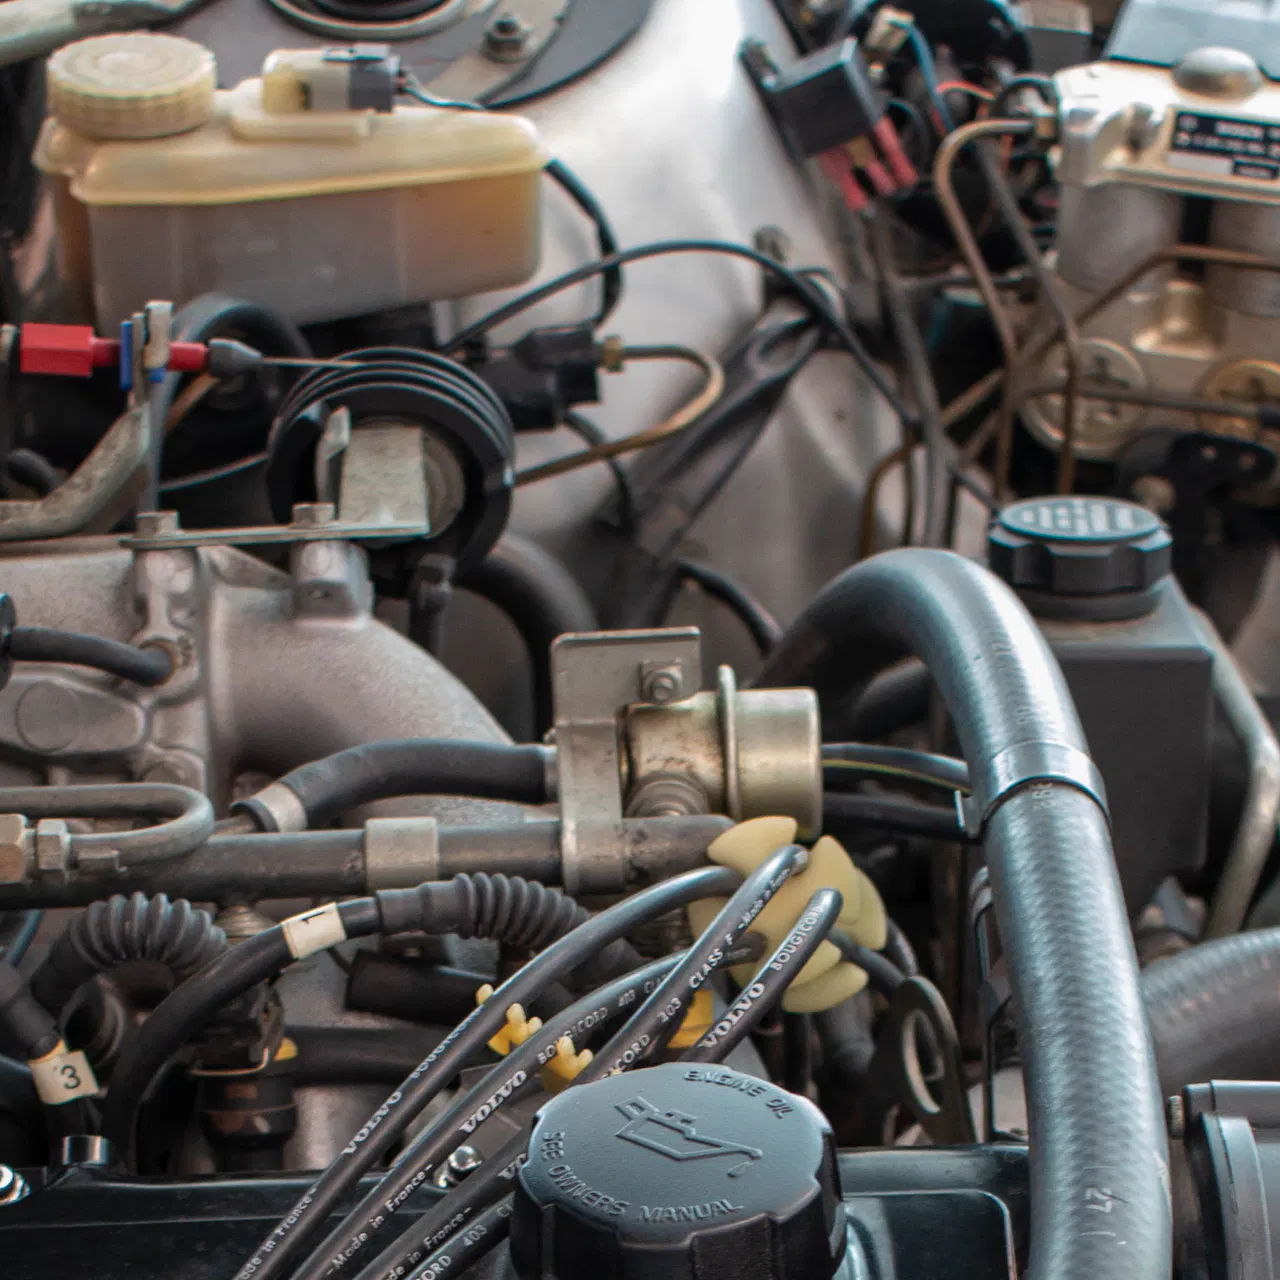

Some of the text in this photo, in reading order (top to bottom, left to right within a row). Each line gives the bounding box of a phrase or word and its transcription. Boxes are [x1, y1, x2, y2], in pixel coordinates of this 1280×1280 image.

[688, 948, 724, 990] CLASS
[697, 981, 766, 1050] VOLVO
[770, 903, 825, 972] BOUGICORD
[60, 1066, 82, 1091] 3
[459, 1069, 528, 1135] VOLVO
[683, 1069, 795, 1120] ENGINE OIL
[340, 1090, 403, 1155] VOLVO
[541, 1131, 566, 1162] SEE
[548, 1164, 631, 1217] OWNERS
[1084, 1186, 1113, 1214] 27
[370, 1214, 385, 1230] in
[639, 1198, 744, 1224] MANUAL
[462, 1223, 488, 1248] 403
[407, 1250, 422, 1265] in
